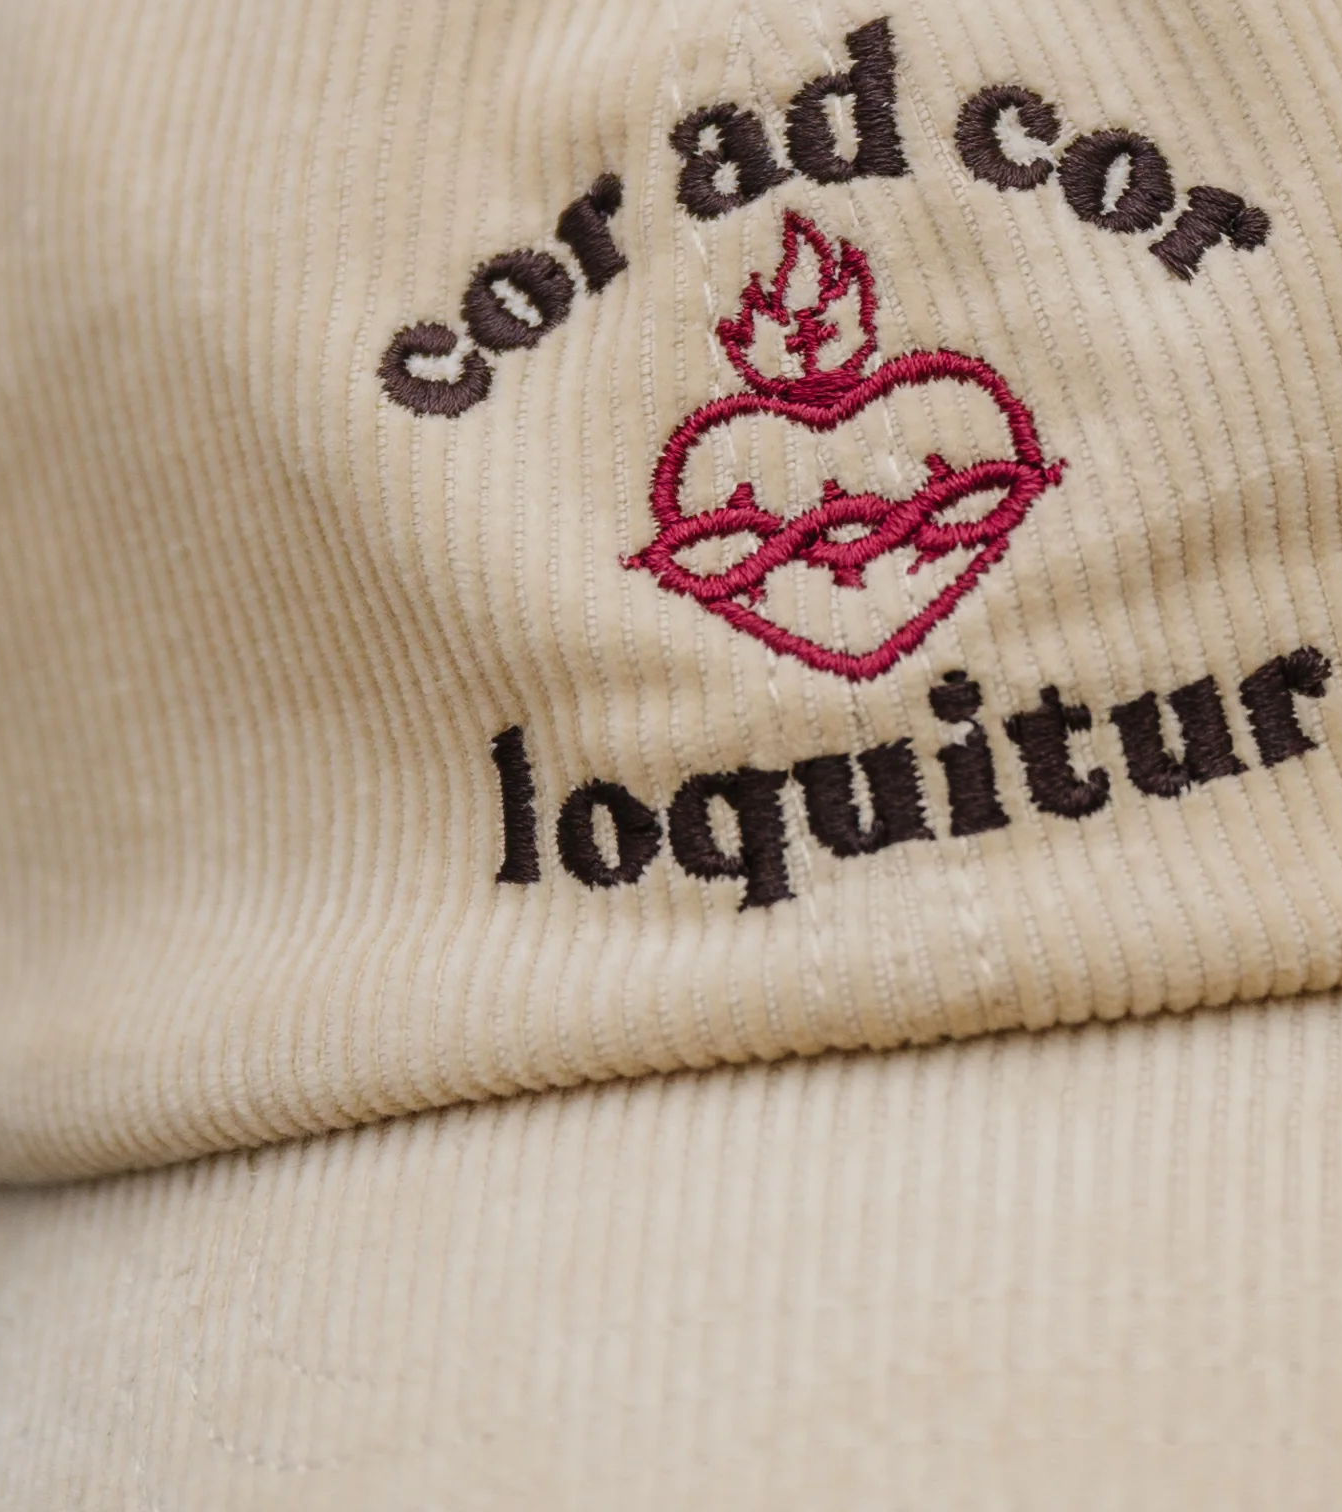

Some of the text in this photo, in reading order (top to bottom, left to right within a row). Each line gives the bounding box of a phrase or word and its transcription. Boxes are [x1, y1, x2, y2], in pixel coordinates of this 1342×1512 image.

[377, 16, 1272, 420] cor ad cor
[490, 645, 1333, 913] loquitur
